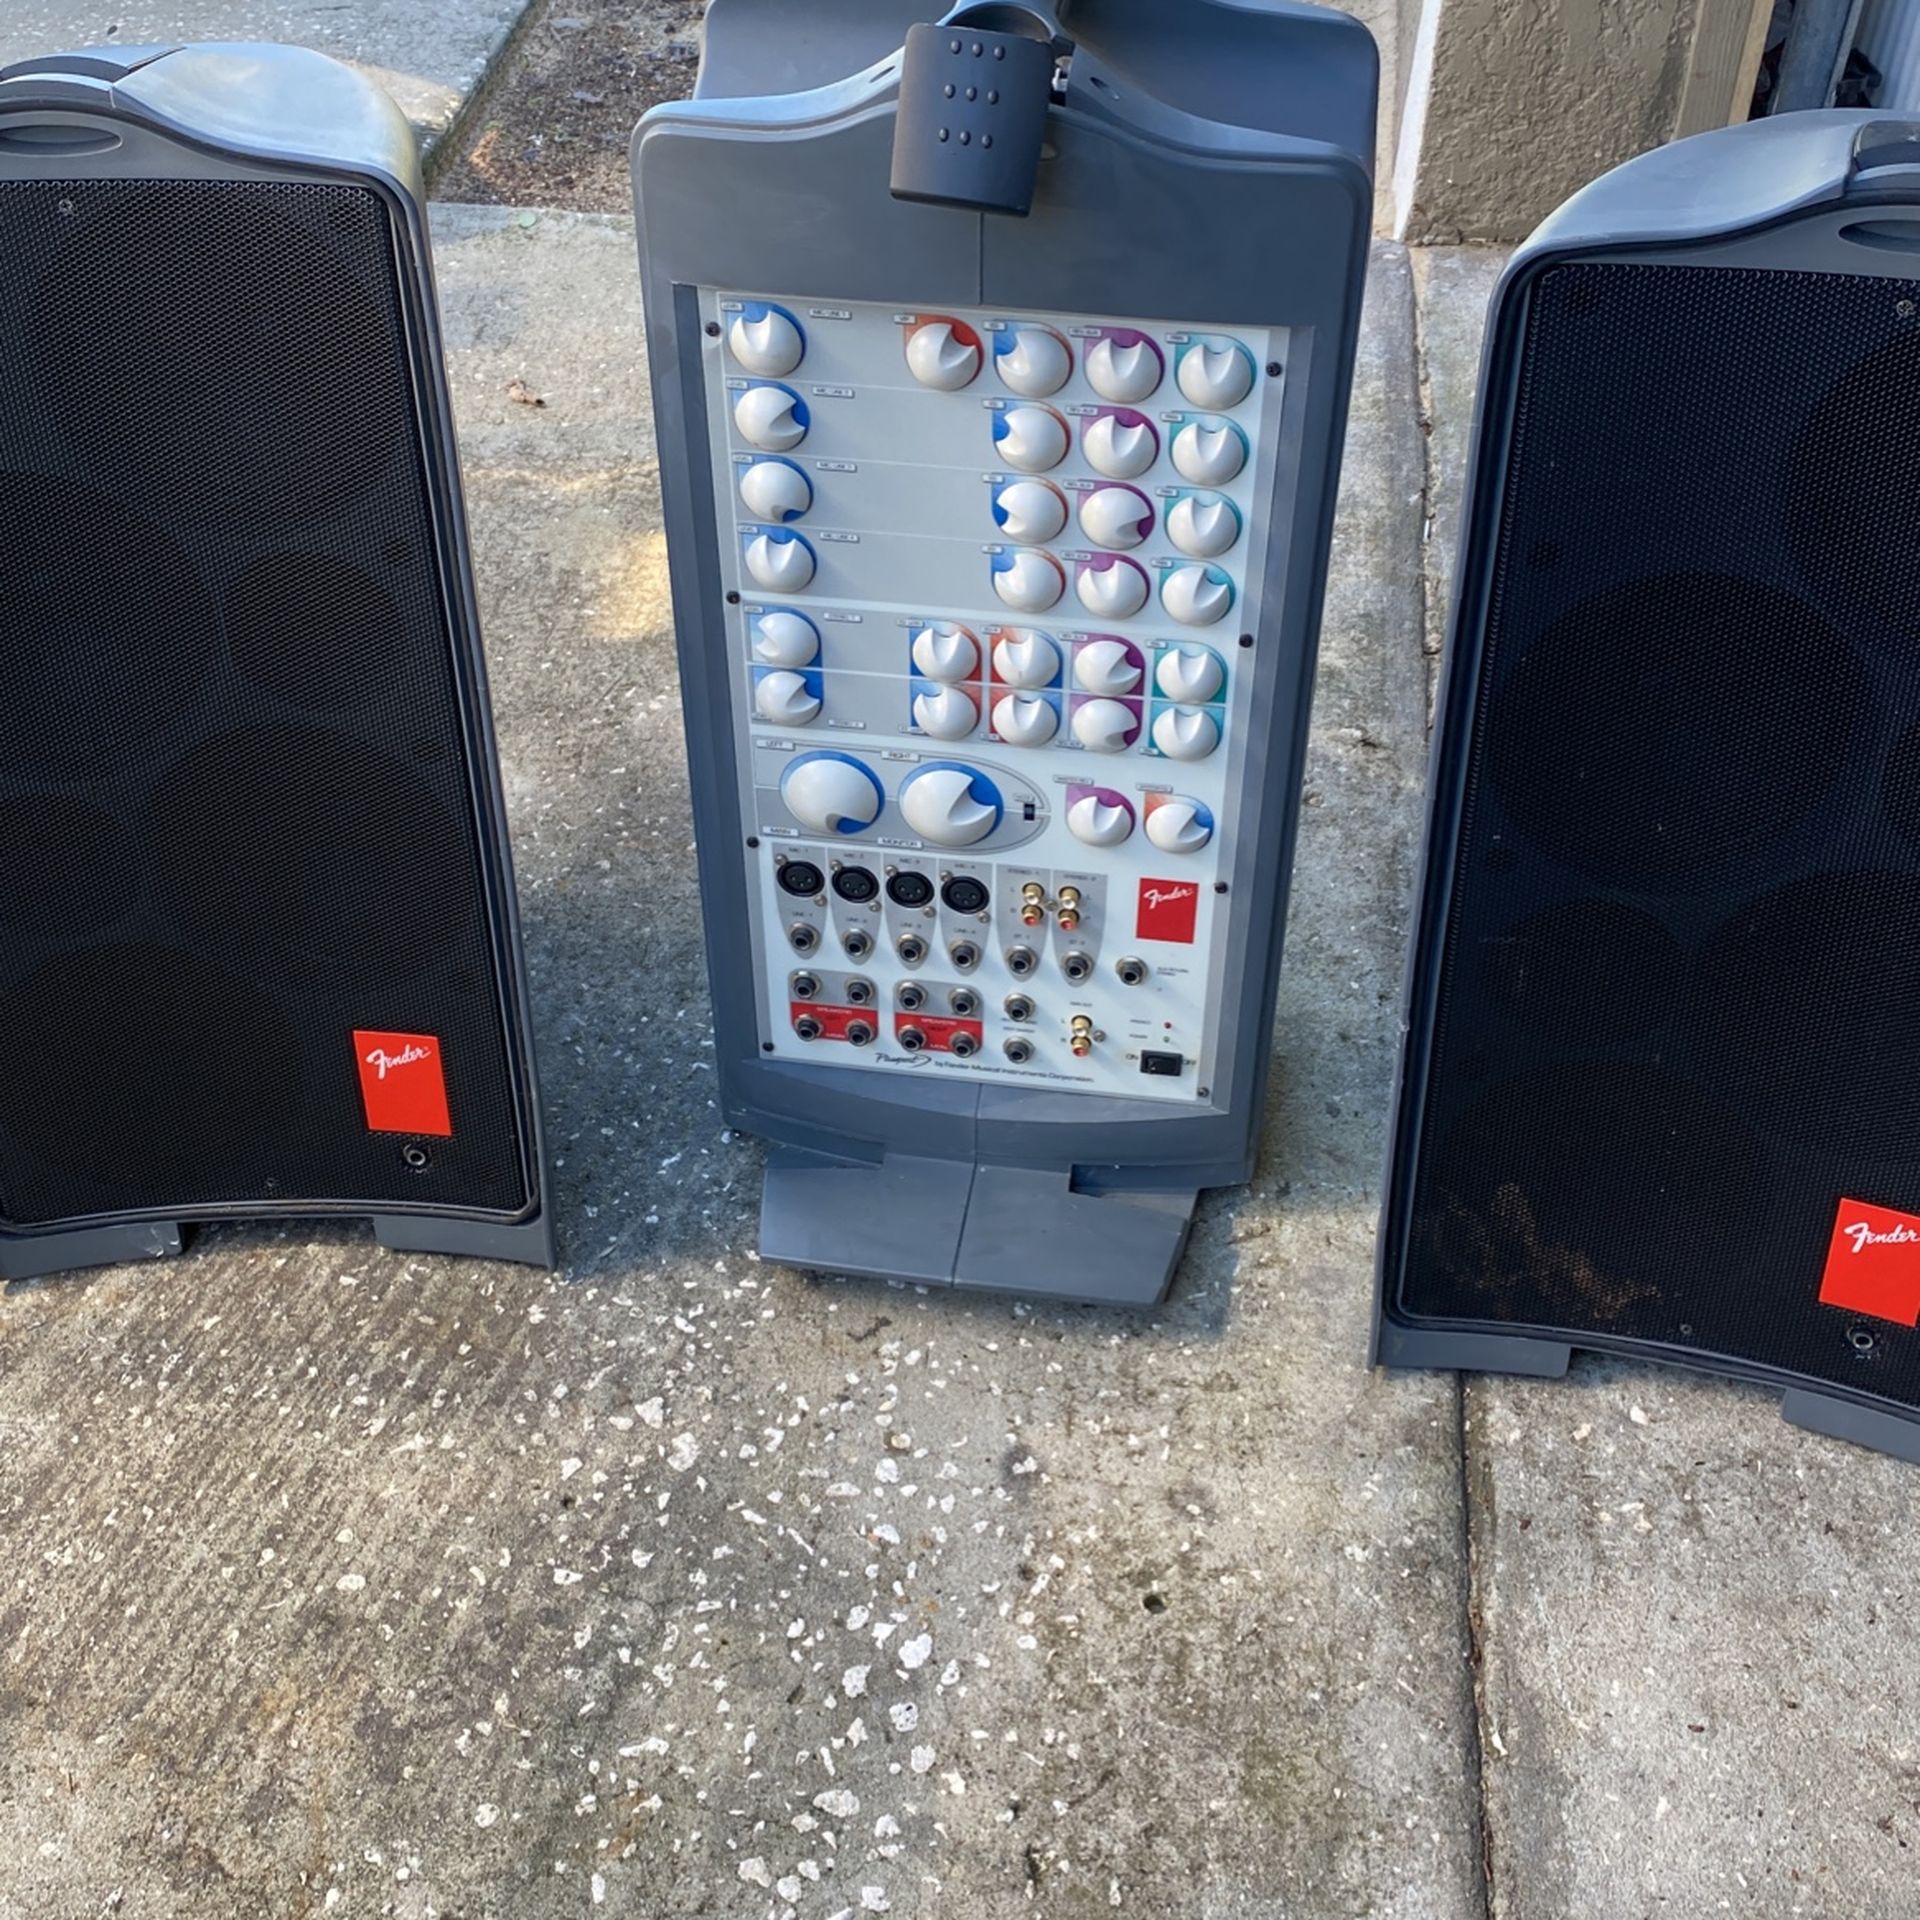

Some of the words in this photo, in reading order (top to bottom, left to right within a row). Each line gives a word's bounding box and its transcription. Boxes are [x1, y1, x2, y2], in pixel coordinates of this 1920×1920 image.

[1143, 886, 1193, 911] Fender
[366, 1044, 432, 1079] Fender
[1844, 1222, 1920, 1253] Fender
